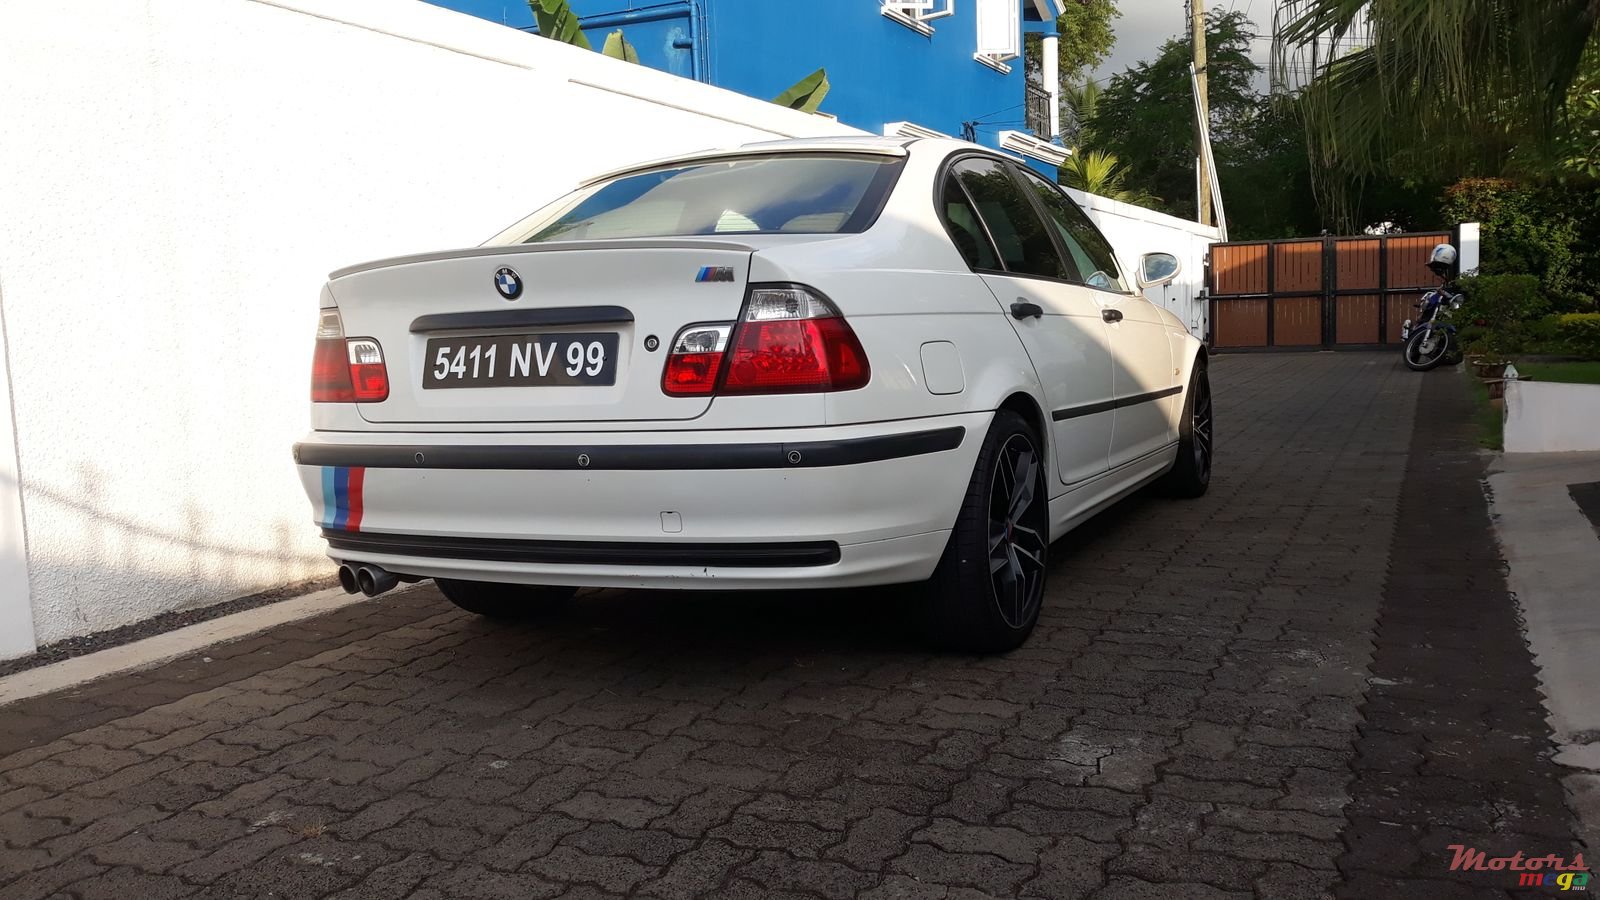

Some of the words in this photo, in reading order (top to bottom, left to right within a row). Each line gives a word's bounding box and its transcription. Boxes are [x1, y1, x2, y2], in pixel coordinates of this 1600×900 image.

[433, 344, 497, 380] 5411
[509, 342, 558, 377] NV
[566, 341, 605, 377] 99
